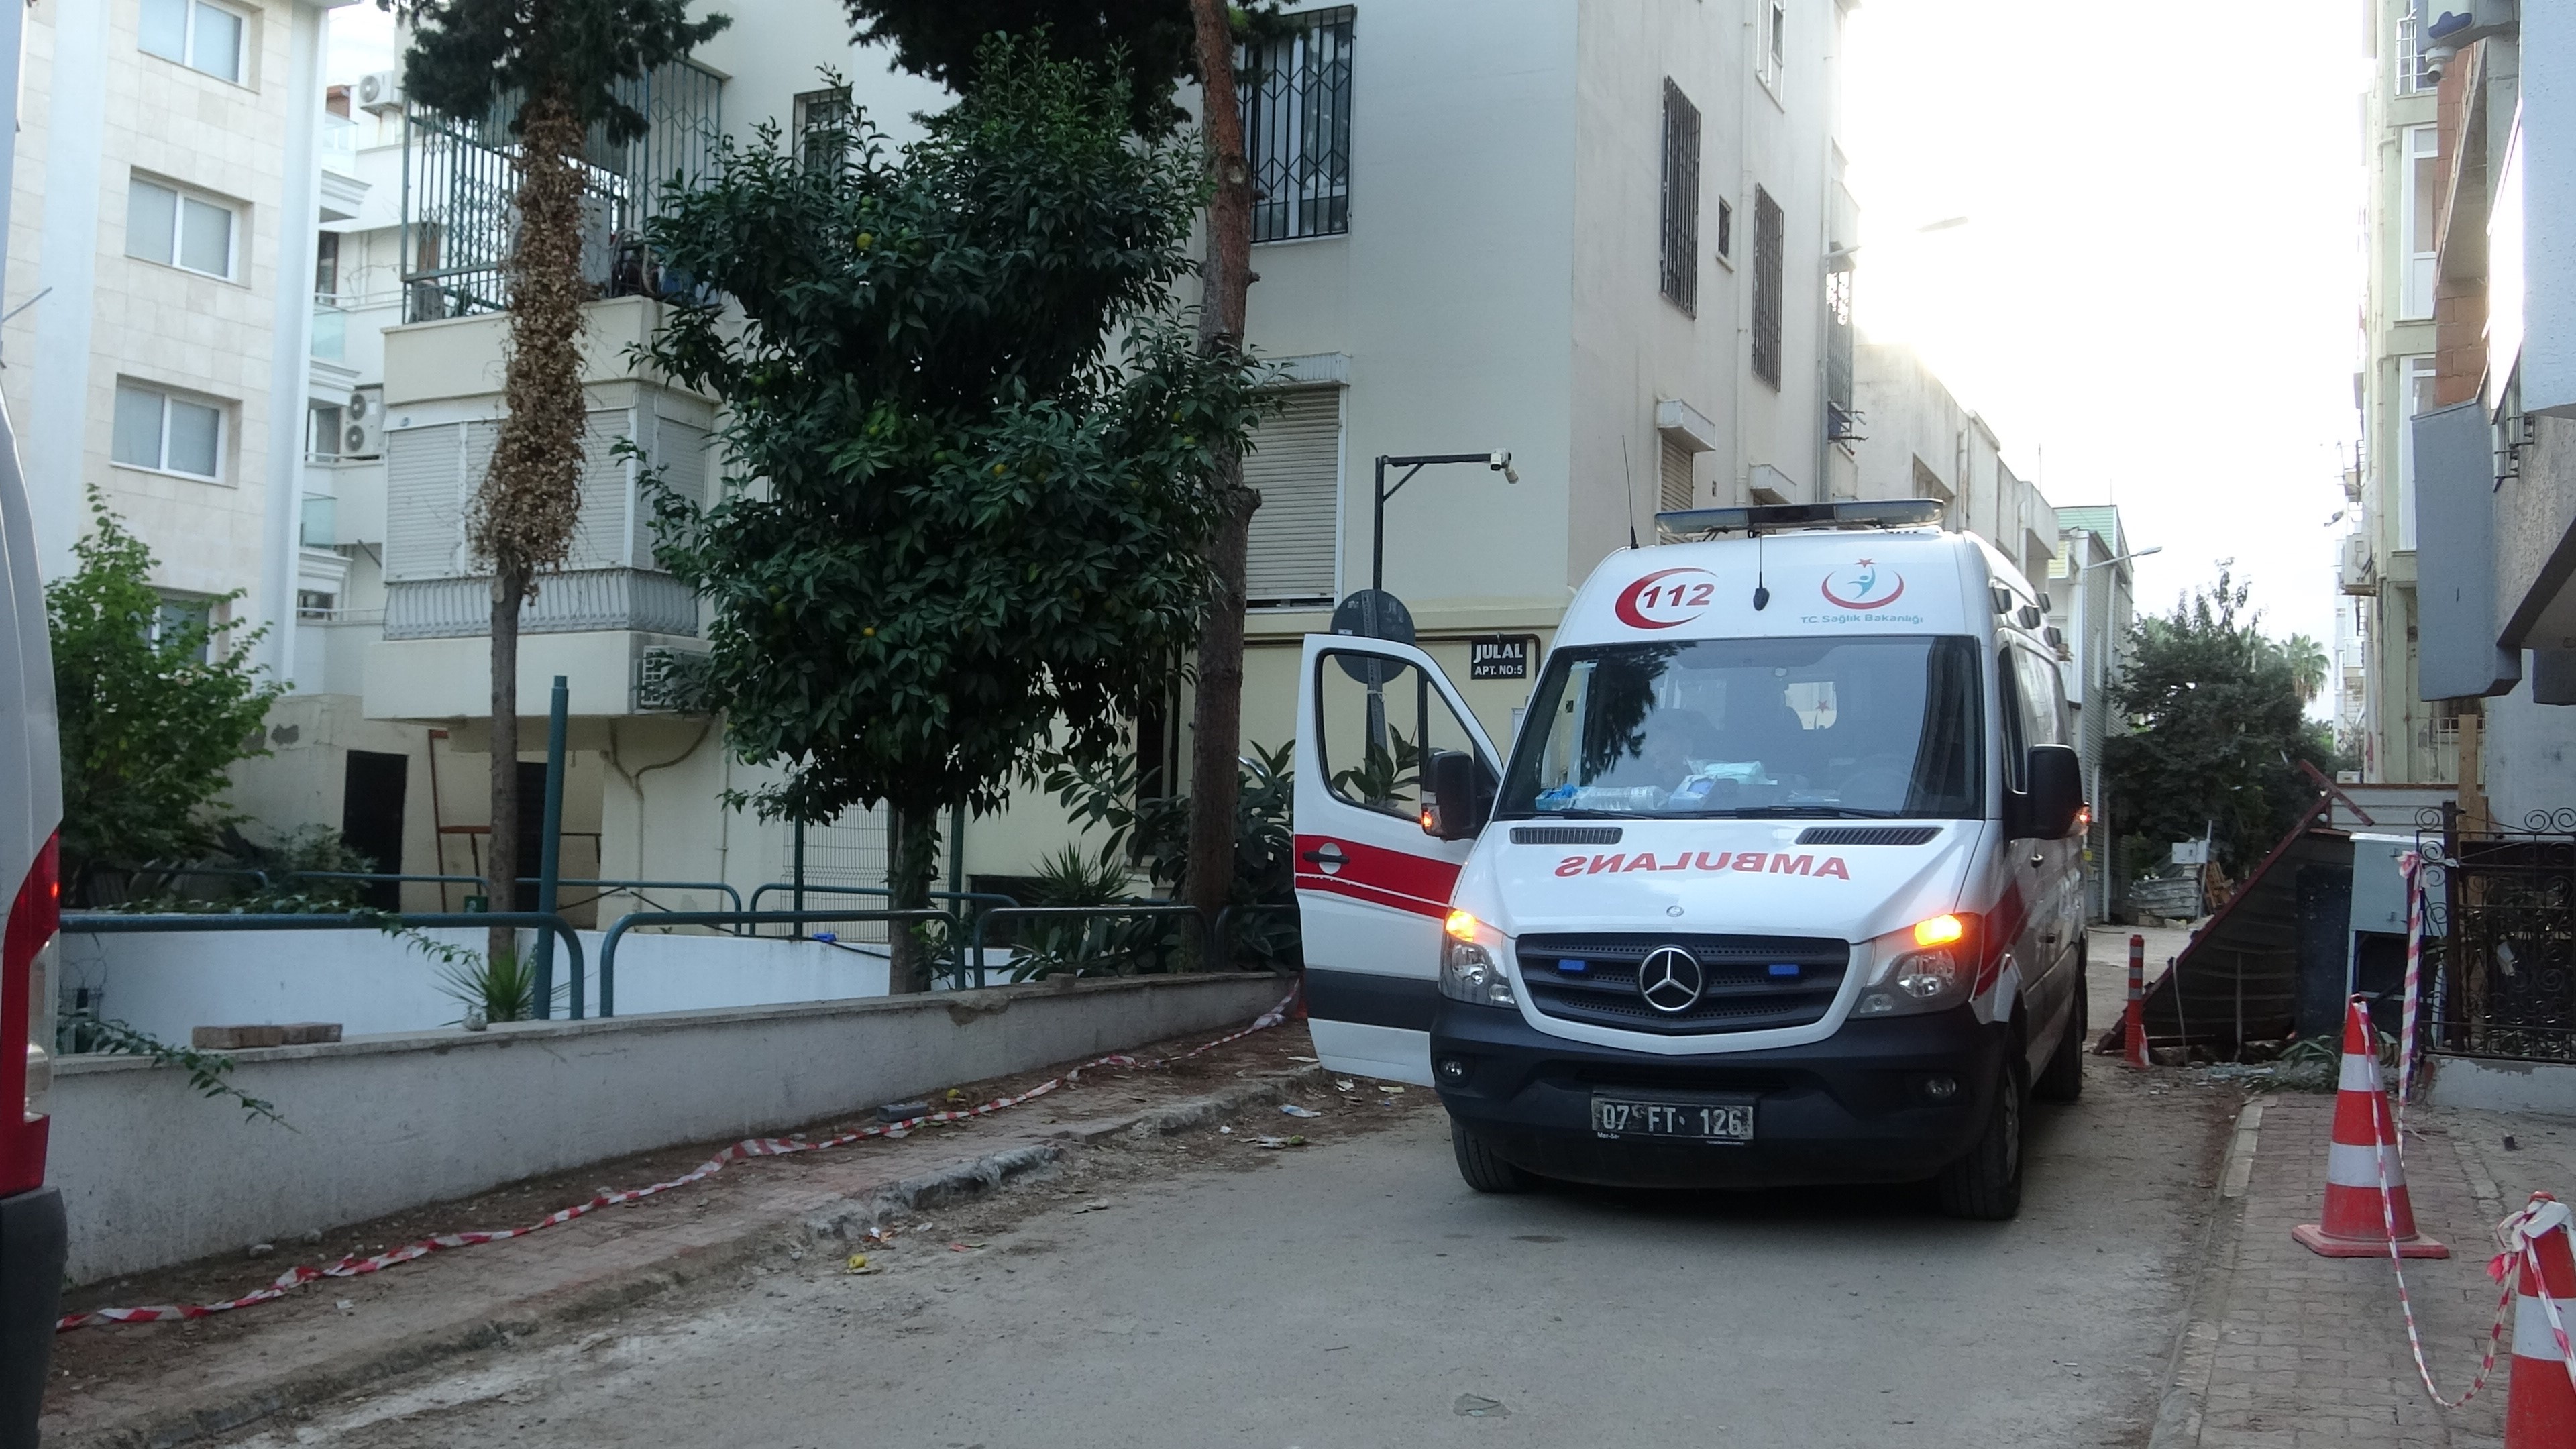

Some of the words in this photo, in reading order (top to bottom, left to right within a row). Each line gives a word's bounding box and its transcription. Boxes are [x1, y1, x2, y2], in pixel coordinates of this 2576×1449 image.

[1643, 583, 1715, 609] 112
[1822, 614, 1861, 625] Sağlık
[1865, 614, 1924, 625] Bakanlığı
[1473, 643, 1523, 663] JULAL
[1474, 665, 1497, 675] APT.
[1499, 665, 1523, 675] NO:5
[1603, 1105, 1629, 1130] 07
[1648, 1106, 1676, 1133] FT
[1700, 1108, 1742, 1136] 126
